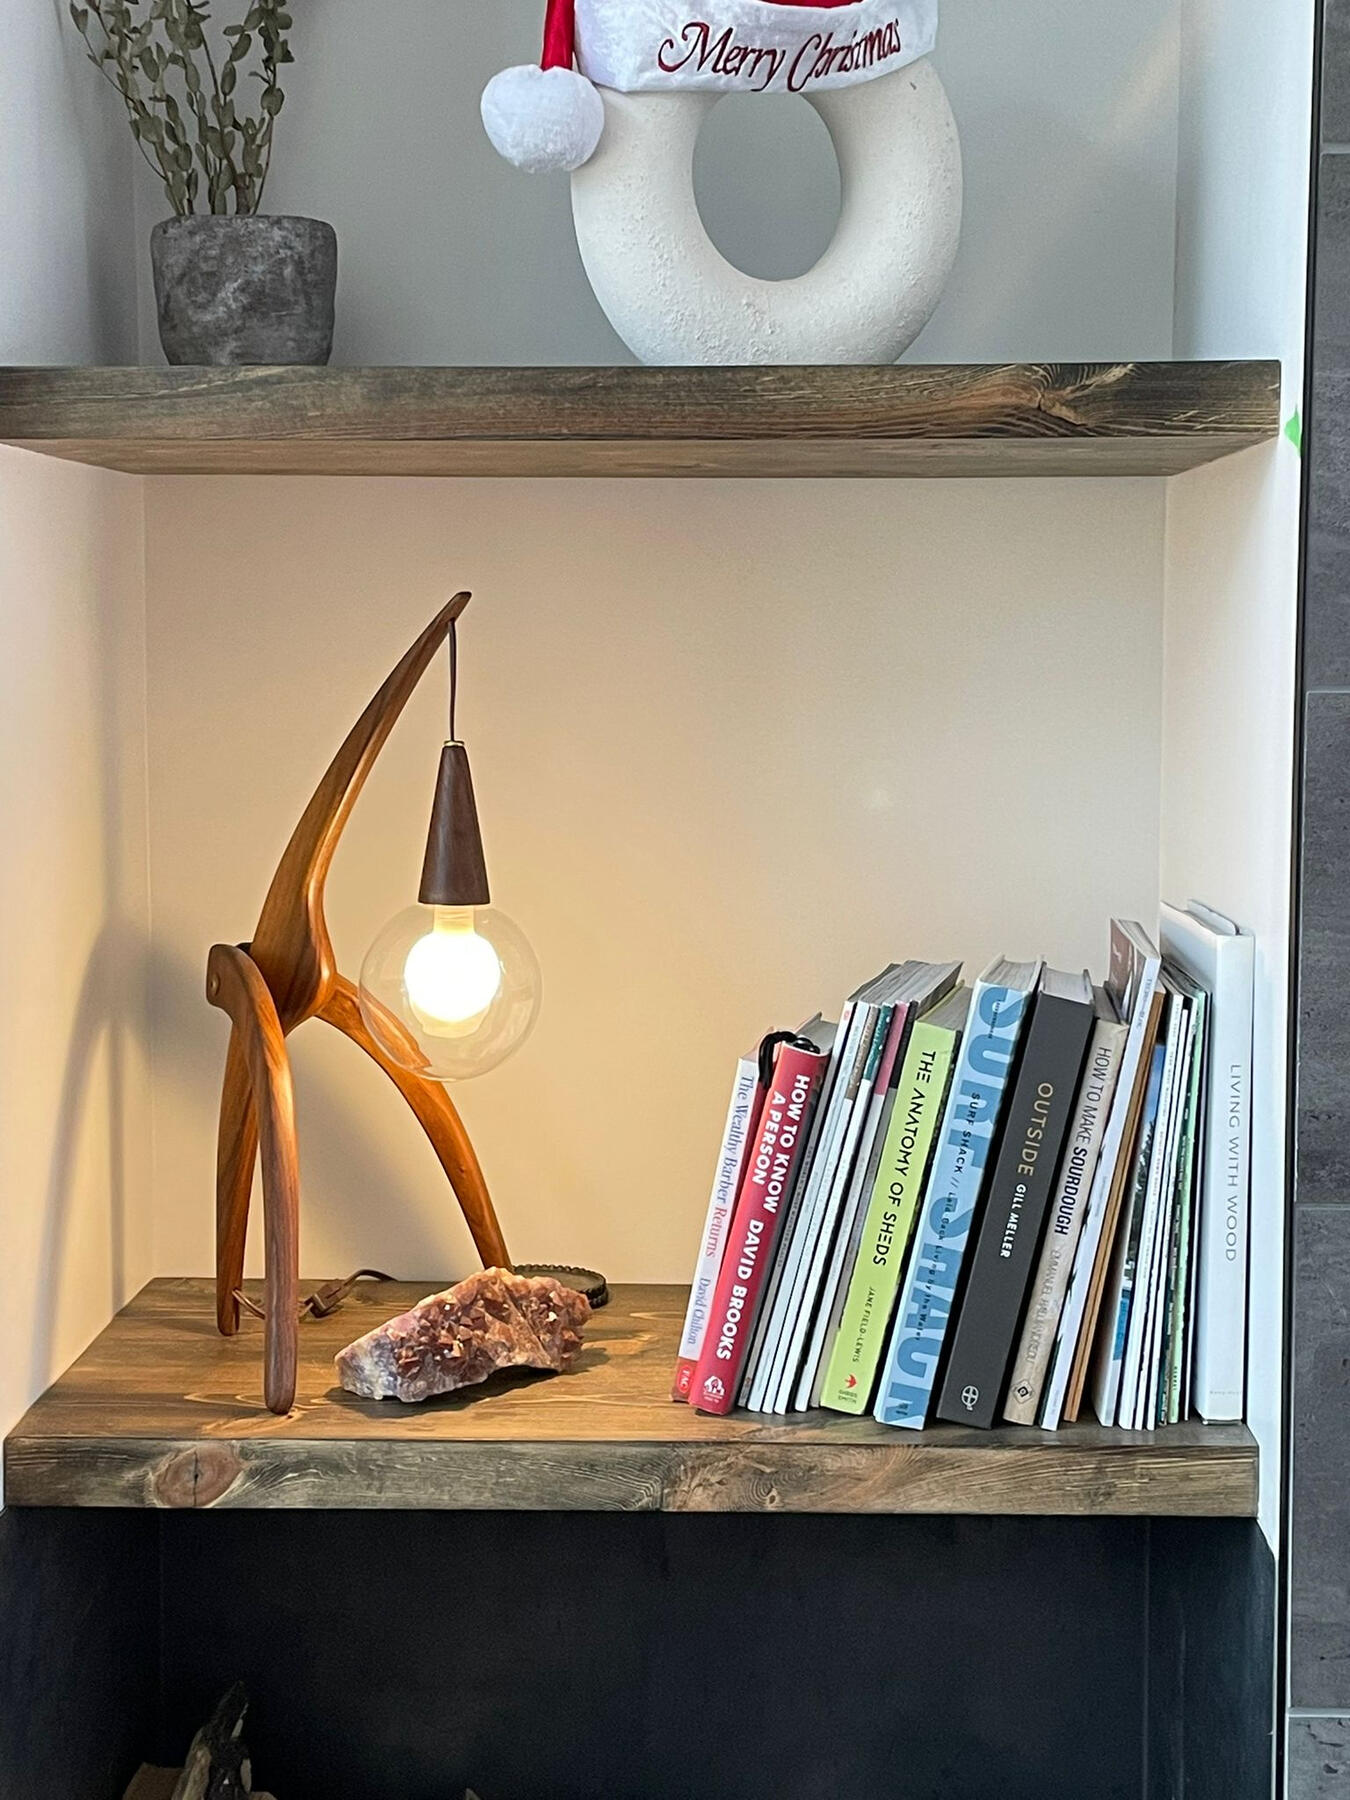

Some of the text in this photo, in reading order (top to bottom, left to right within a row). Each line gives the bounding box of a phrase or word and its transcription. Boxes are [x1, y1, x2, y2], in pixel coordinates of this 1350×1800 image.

[658, 18, 901, 92] Merry Christmas
[787, 1074, 810, 1120] HOW
[966, 1092, 980, 1126] SURF
[706, 1076, 754, 1257] The Wealthy Barber Returns
[752, 1091, 786, 1185] A PERSON
[780, 1125, 798, 1148] TO
[873, 1051, 936, 1266] THE ANATOMY OF SHEDS
[954, 1130, 972, 1173] SHACK
[1000, 1082, 1053, 1258] OUTSIDE GILL MELLER
[1054, 1047, 1111, 1235] HOW TO MAKE SOURDOUGH
[1225, 1064, 1241, 1262] LIVING WITH WOOD
[763, 1153, 791, 1213] KNOW
[687, 1277, 711, 1345] David Chilton
[716, 1219, 764, 1360] DAVID BROOKS
[866, 1286, 876, 1308] JANE
